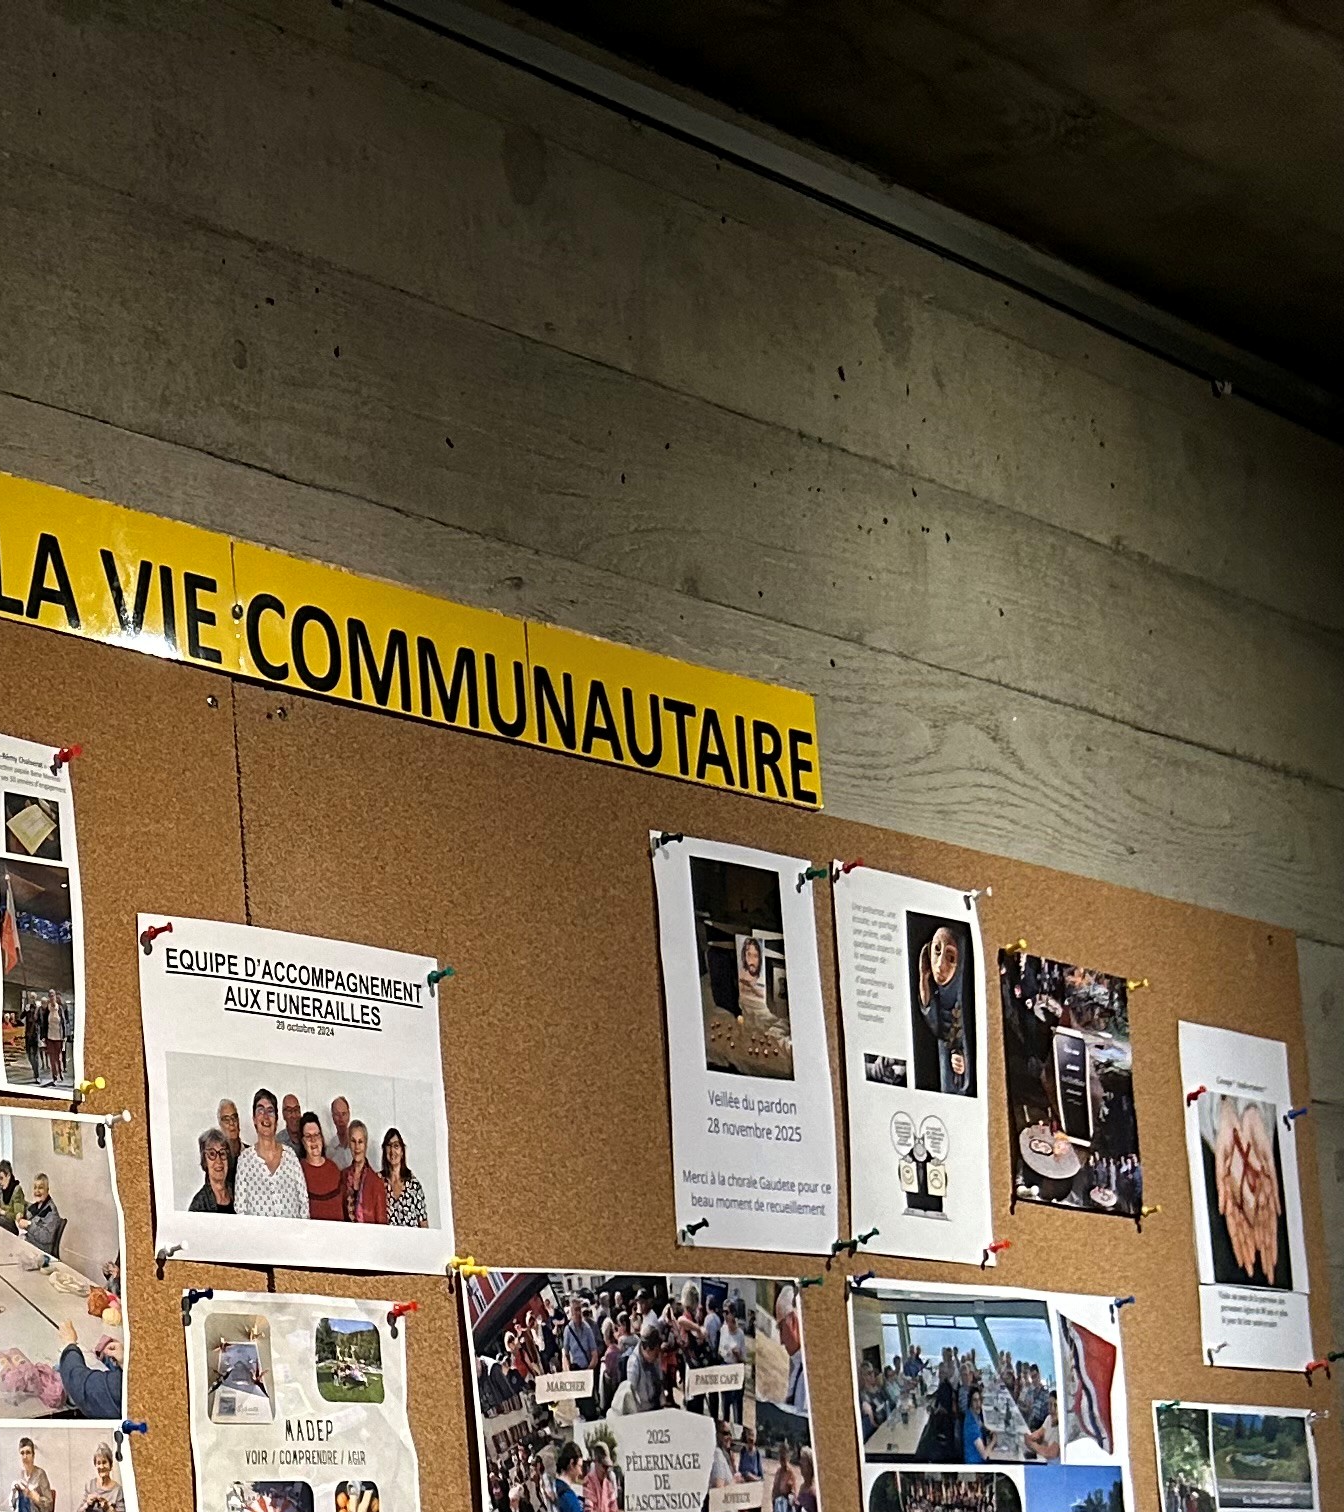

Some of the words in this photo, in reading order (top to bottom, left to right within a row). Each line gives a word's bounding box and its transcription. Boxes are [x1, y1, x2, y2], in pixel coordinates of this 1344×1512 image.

[99, 548, 224, 662] VIE
[243, 591, 818, 804] COMMUNAUTAIRE
[165, 947, 239, 976] EQUIPE
[244, 956, 422, 1004] D’ACCOMPAGNEMENT
[224, 985, 262, 1011] AUX
[266, 990, 382, 1027] FUNERAILLES
[707, 1089, 741, 1110] Veillée
[741, 1094, 755, 1112] du
[757, 1098, 797, 1116] pardon
[706, 1117, 720, 1135] 28
[722, 1121, 773, 1141] novembre
[774, 1125, 802, 1143] 2025
[682, 1169, 709, 1185] Merci
[717, 1171, 726, 1186] la
[727, 1173, 758, 1190] chorale
[797, 1181, 819, 1196] pour
[820, 1183, 832, 1195] ce
[691, 1192, 715, 1208] beau
[715, 1197, 753, 1211] moment
[754, 1198, 765, 1212] de
[765, 1200, 827, 1217] recueillement
[545, 1380, 586, 1393] MARCHER
[285, 1419, 334, 1442] MADEP
[645, 1428, 672, 1446] 2025
[245, 1449, 268, 1466] VOIR
[347, 1449, 367, 1466] AGIR
[653, 1473, 672, 1491] DE
[625, 1490, 703, 1512] L’ASCENSION
